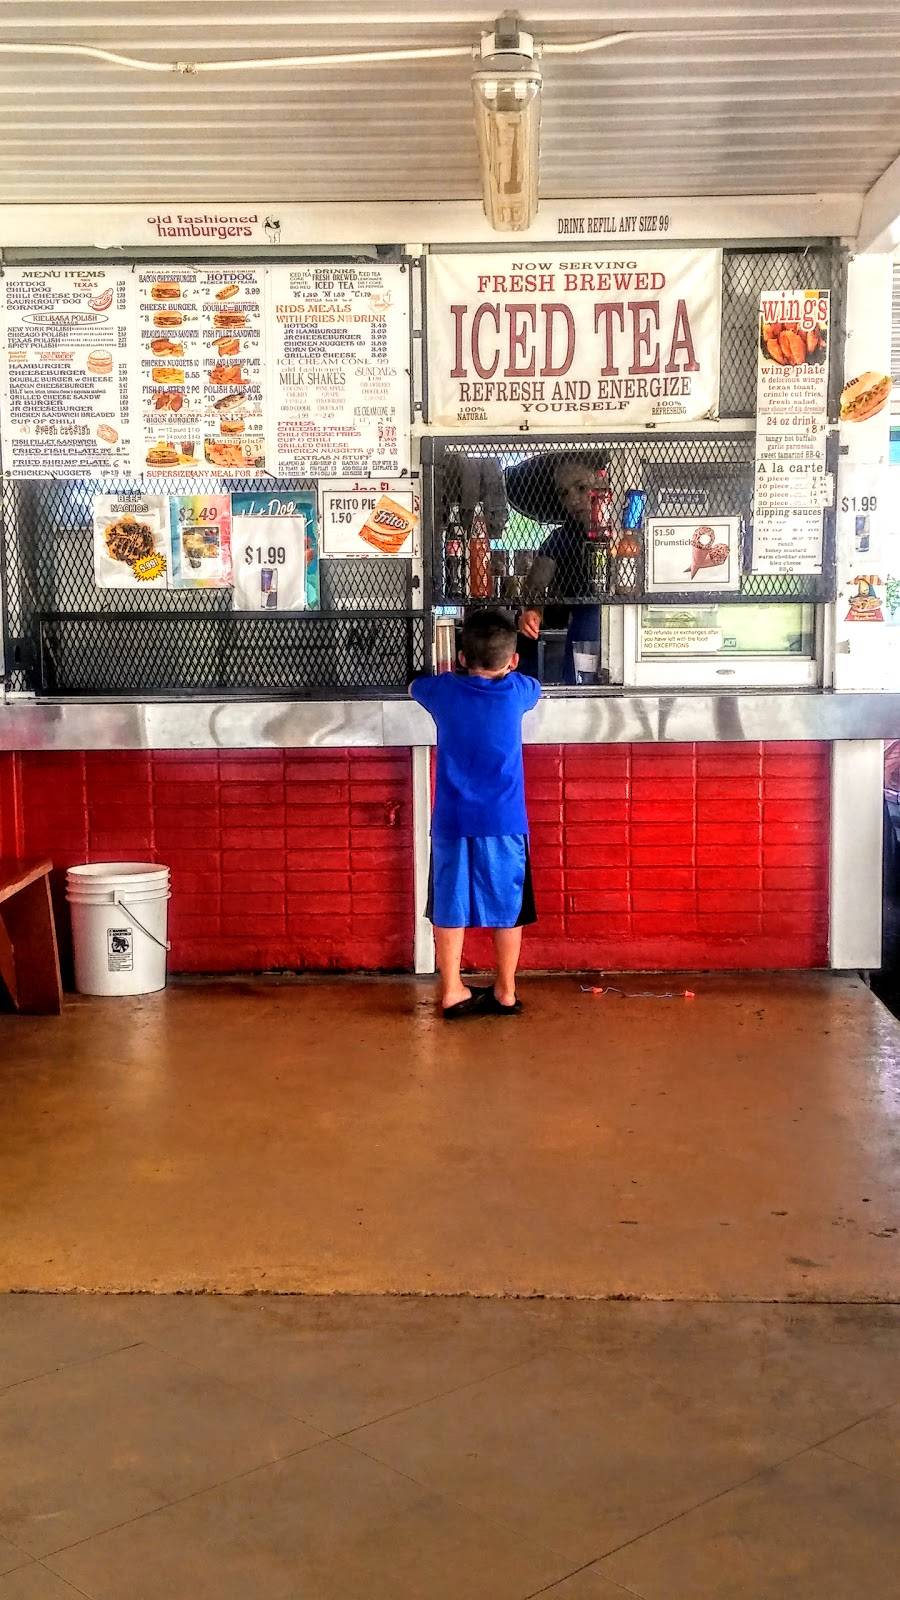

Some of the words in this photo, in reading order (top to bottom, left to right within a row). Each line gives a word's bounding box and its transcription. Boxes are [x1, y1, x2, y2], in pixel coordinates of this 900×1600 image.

[147, 215, 172, 223] old
[177, 215, 258, 223] fashioned
[558, 218, 585, 234] DRINK
[587, 217, 617, 233] REFILL
[619, 216, 637, 232] ANY
[639, 215, 658, 232] SIZE
[659, 215, 670, 231] 99
[157, 224, 252, 239] hamburgers
[511, 263, 553, 271] NOW
[559, 261, 638, 270] SERVING
[22, 270, 61, 278] MENU
[64, 270, 106, 278] ITEMS
[315, 282, 334, 290] ICED
[338, 282, 354, 290] TEA
[477, 275, 556, 293] FRESH
[564, 272, 666, 291] BREWED
[762, 300, 827, 329] wings
[450, 302, 576, 380] ICED
[594, 299, 700, 377] TEA
[761, 365, 791, 377] wing
[796, 365, 825, 377] plate
[280, 373, 304, 385] MILK
[308, 373, 346, 385] SHAKES
[459, 382, 545, 402] REFRESH
[552, 381, 591, 401] AND
[598, 377, 692, 399] ENERGIZE
[521, 401, 630, 413] YOURSELF
[652, 406, 687, 416] REFRESHING
[457, 412, 488, 421] NATURAL
[767, 416, 777, 425] 24
[780, 416, 790, 425] oz
[793, 416, 816, 425] drink
[757, 463, 767, 473] A
[772, 463, 784, 473] la
[789, 463, 823, 473] carte
[111, 504, 149, 512] NACHOS
[268, 499, 296, 516] Dog
[330, 499, 358, 510] FRITO
[362, 499, 376, 510] PIE
[842, 496, 877, 512] $1.99
[179, 507, 217, 521] $2.49
[331, 513, 351, 524] 1.50
[756, 508, 790, 518] dipping
[792, 508, 821, 518] sauces
[374, 510, 408, 531] Fritos
[654, 528, 675, 537] $1.50
[245, 546, 286, 565] $1.99
